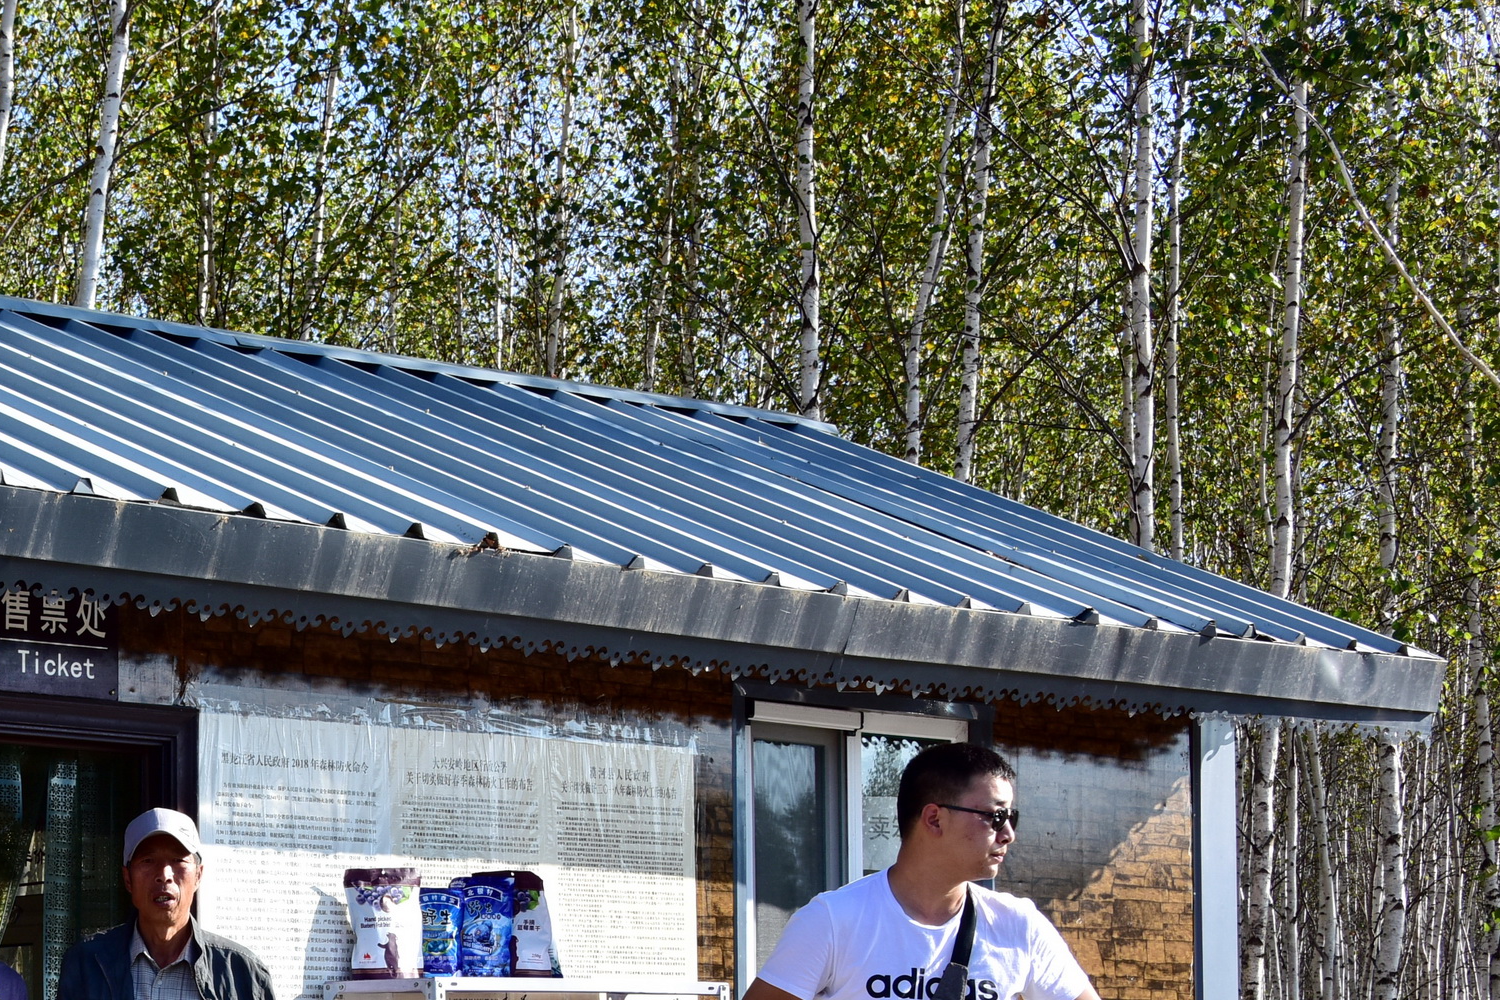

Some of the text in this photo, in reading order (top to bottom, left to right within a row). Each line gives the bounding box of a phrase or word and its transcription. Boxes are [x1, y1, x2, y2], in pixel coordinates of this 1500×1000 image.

[0, 588, 107, 639] 售票处
[17, 649, 95, 680] Ticket
[589, 766, 650, 782] 漠河县人民政府
